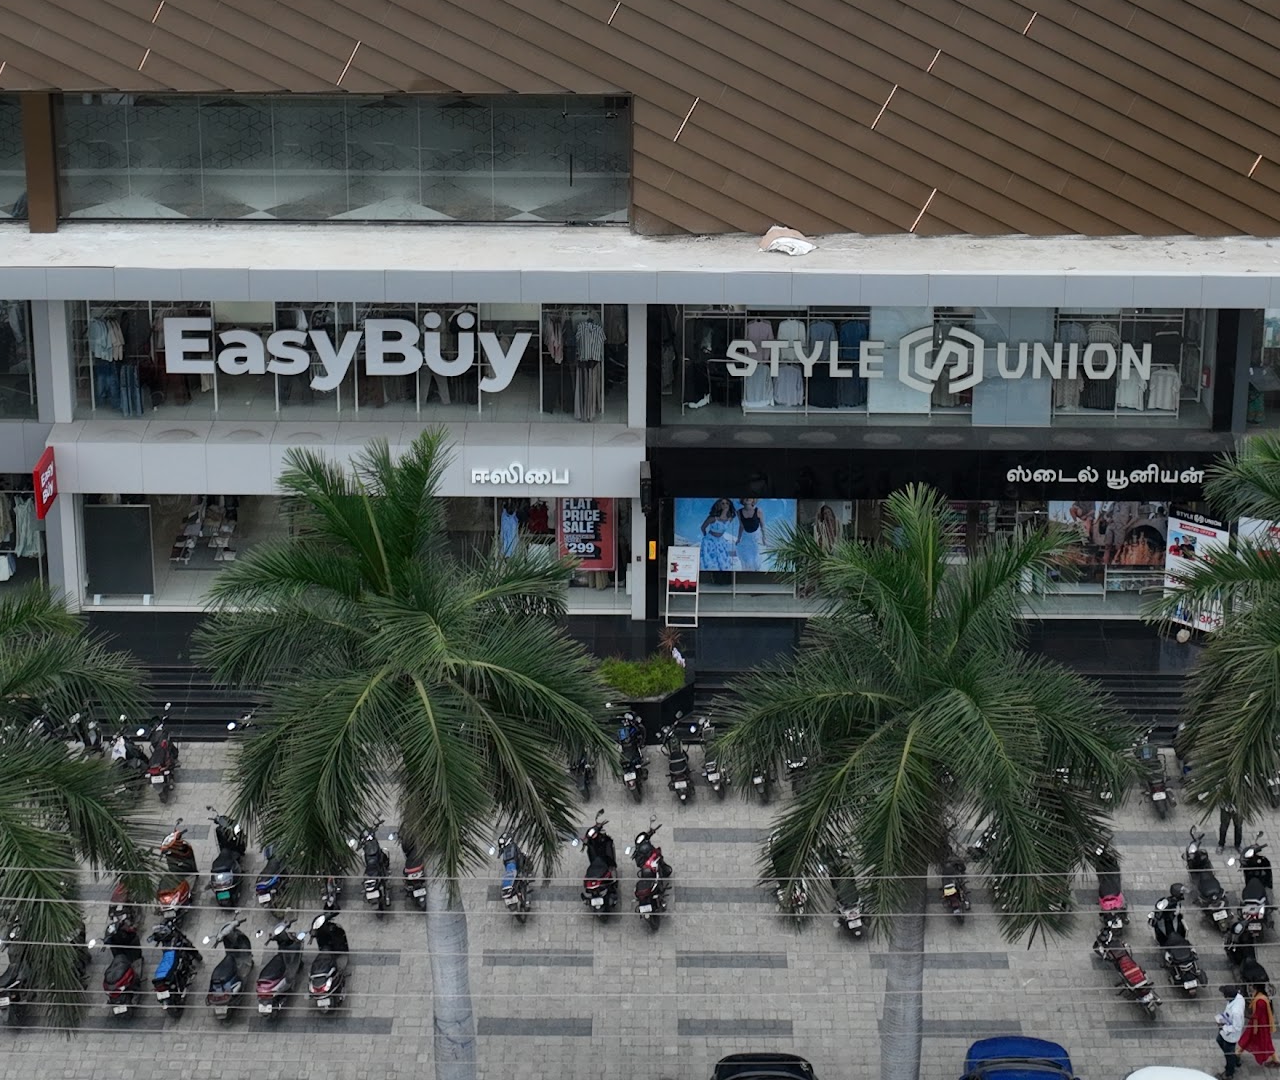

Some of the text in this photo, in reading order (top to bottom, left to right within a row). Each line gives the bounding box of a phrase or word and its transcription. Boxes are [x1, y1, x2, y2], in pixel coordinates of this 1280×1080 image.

[725, 339, 1152, 381] STYLE UNION
[562, 498, 593, 510] FLAT
[562, 510, 600, 521] PRICE
[562, 521, 595, 533] SALE
